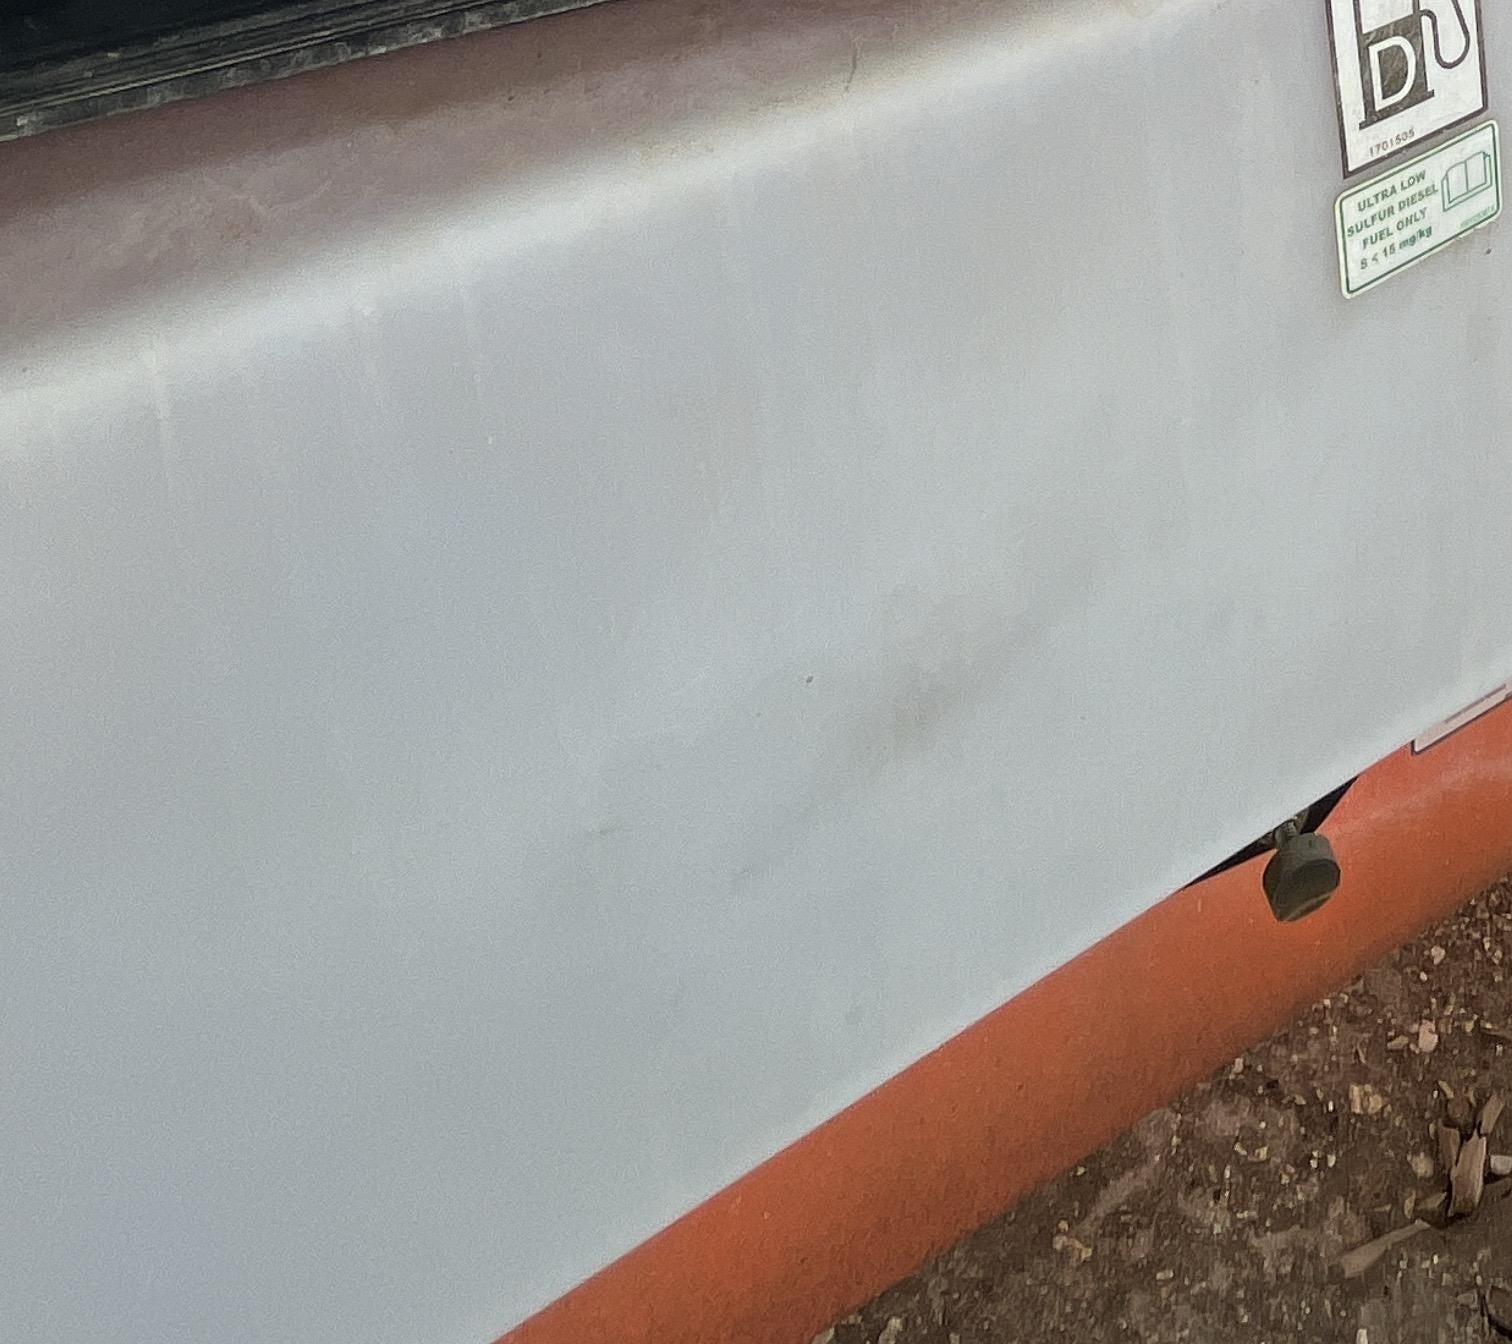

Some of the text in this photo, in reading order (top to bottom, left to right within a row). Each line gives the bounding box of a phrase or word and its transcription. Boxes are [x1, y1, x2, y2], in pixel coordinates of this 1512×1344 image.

[1368, 35, 1416, 112] D
[1347, 183, 1439, 238] SULFUR DIESEL
[1357, 170, 1426, 212] ULTRA LOW
[1362, 206, 1428, 250] FUEL ONLY
[1383, 243, 1396, 259] 15
[1399, 226, 1433, 250] mg/kg
